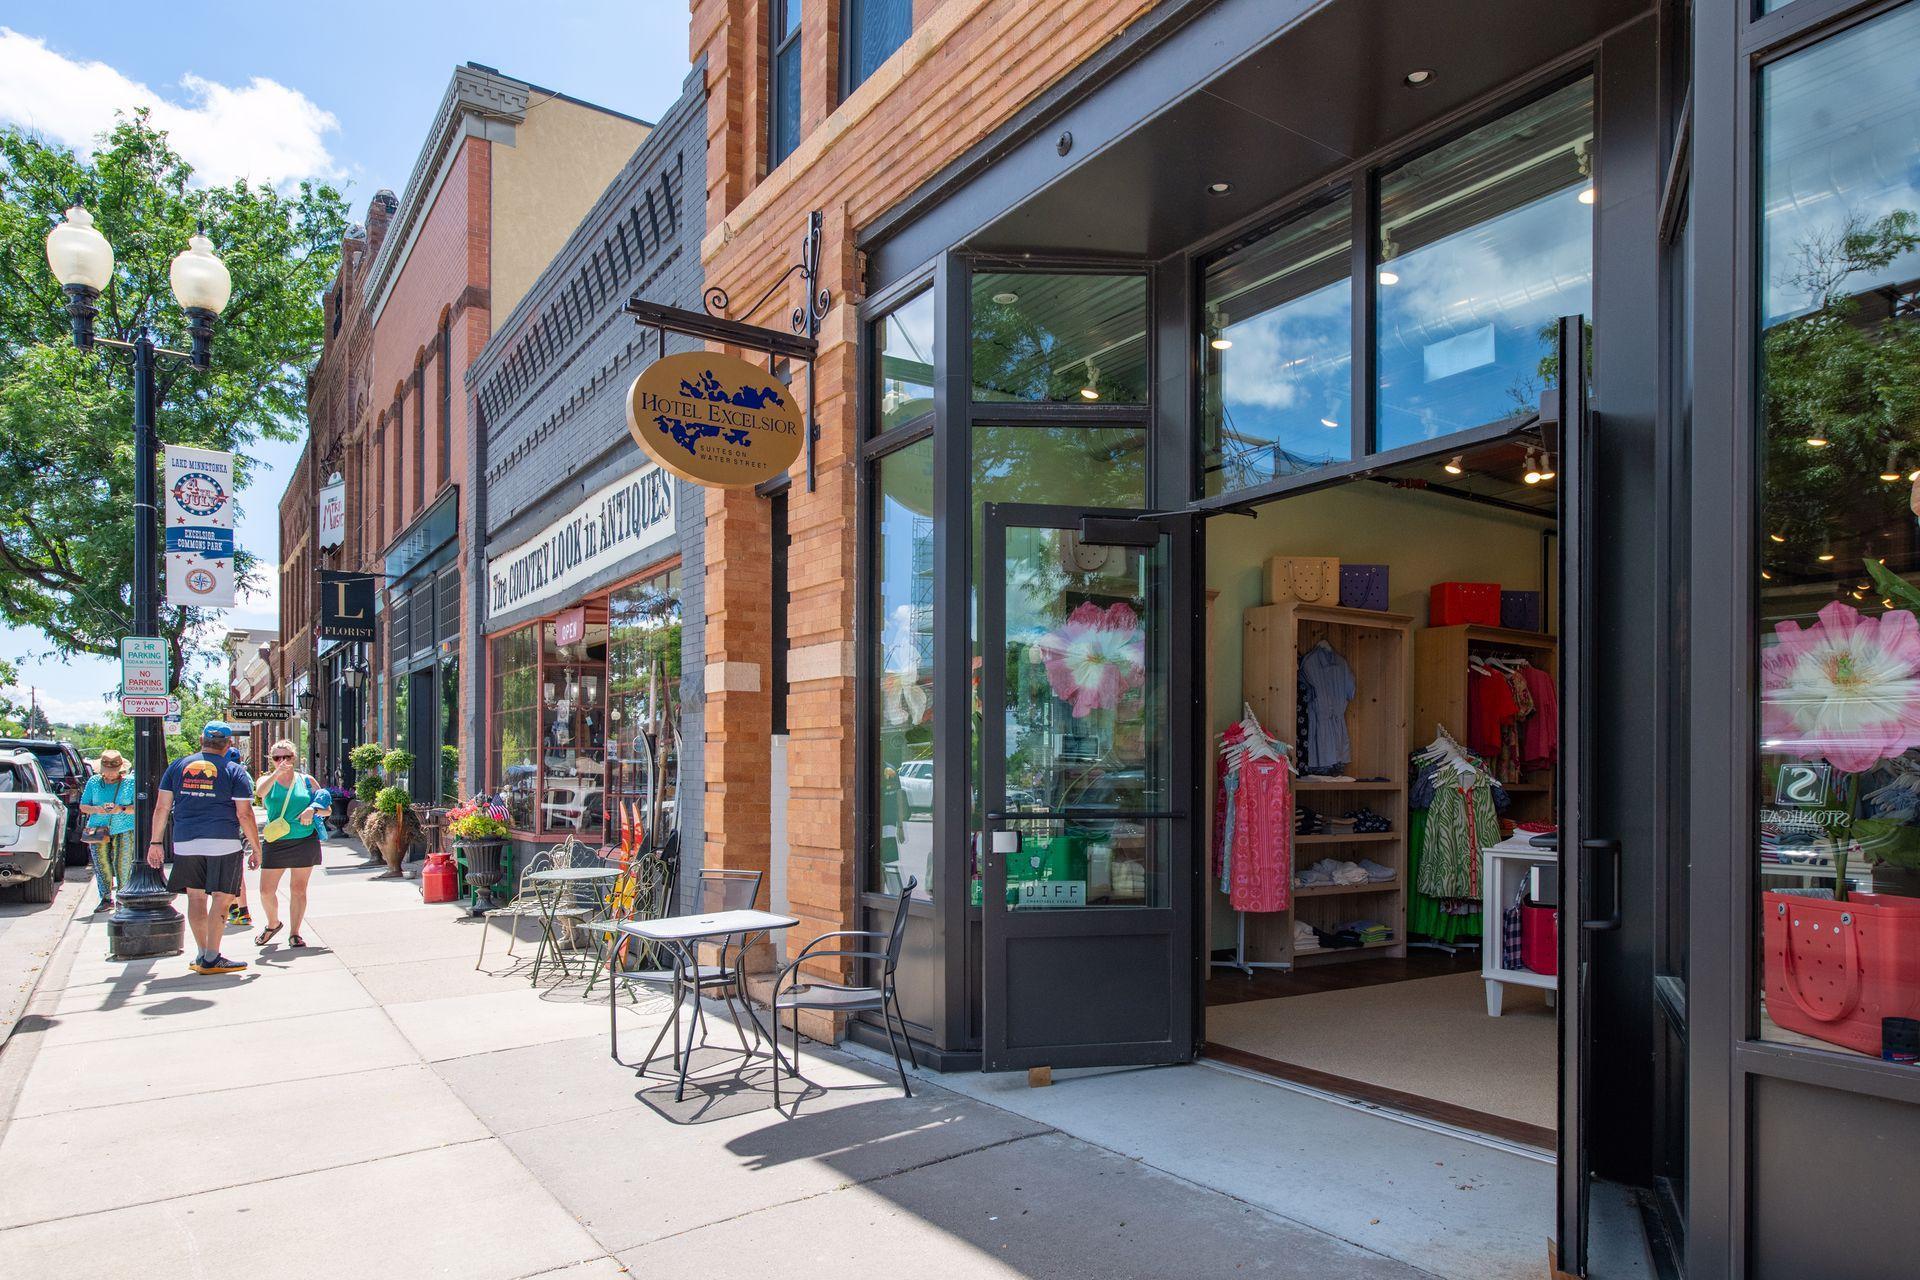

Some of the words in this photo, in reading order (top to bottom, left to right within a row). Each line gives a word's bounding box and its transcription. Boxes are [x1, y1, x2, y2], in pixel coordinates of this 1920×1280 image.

[641, 392, 702, 419] HOTEL
[708, 404, 797, 436] EXCELSIOR
[700, 445, 733, 456] SUITES
[735, 450, 747, 458] ON
[171, 458, 187, 469] LAKE
[189, 460, 228, 474] MINNETONKA
[700, 454, 731, 464] WATER
[733, 459, 769, 469] STREET
[184, 529, 216, 540] EXCELSIOR
[493, 572, 508, 611] The
[509, 542, 549, 604] COUNTRY
[552, 516, 582, 580] LOOK
[583, 512, 597, 560] in
[598, 466, 672, 554] ANTIQUES
[177, 538, 206, 550] COMMONS
[207, 541, 223, 551] PARK
[334, 582, 364, 619] L
[325, 626, 374, 637] FLORIST
[562, 621, 577, 641] OPEN
[144, 643, 155, 651] HR
[128, 651, 162, 660] PARKING
[139, 670, 151, 678] NO
[128, 679, 163, 687] PARKING
[1026, 885, 1078, 898] DIFF
